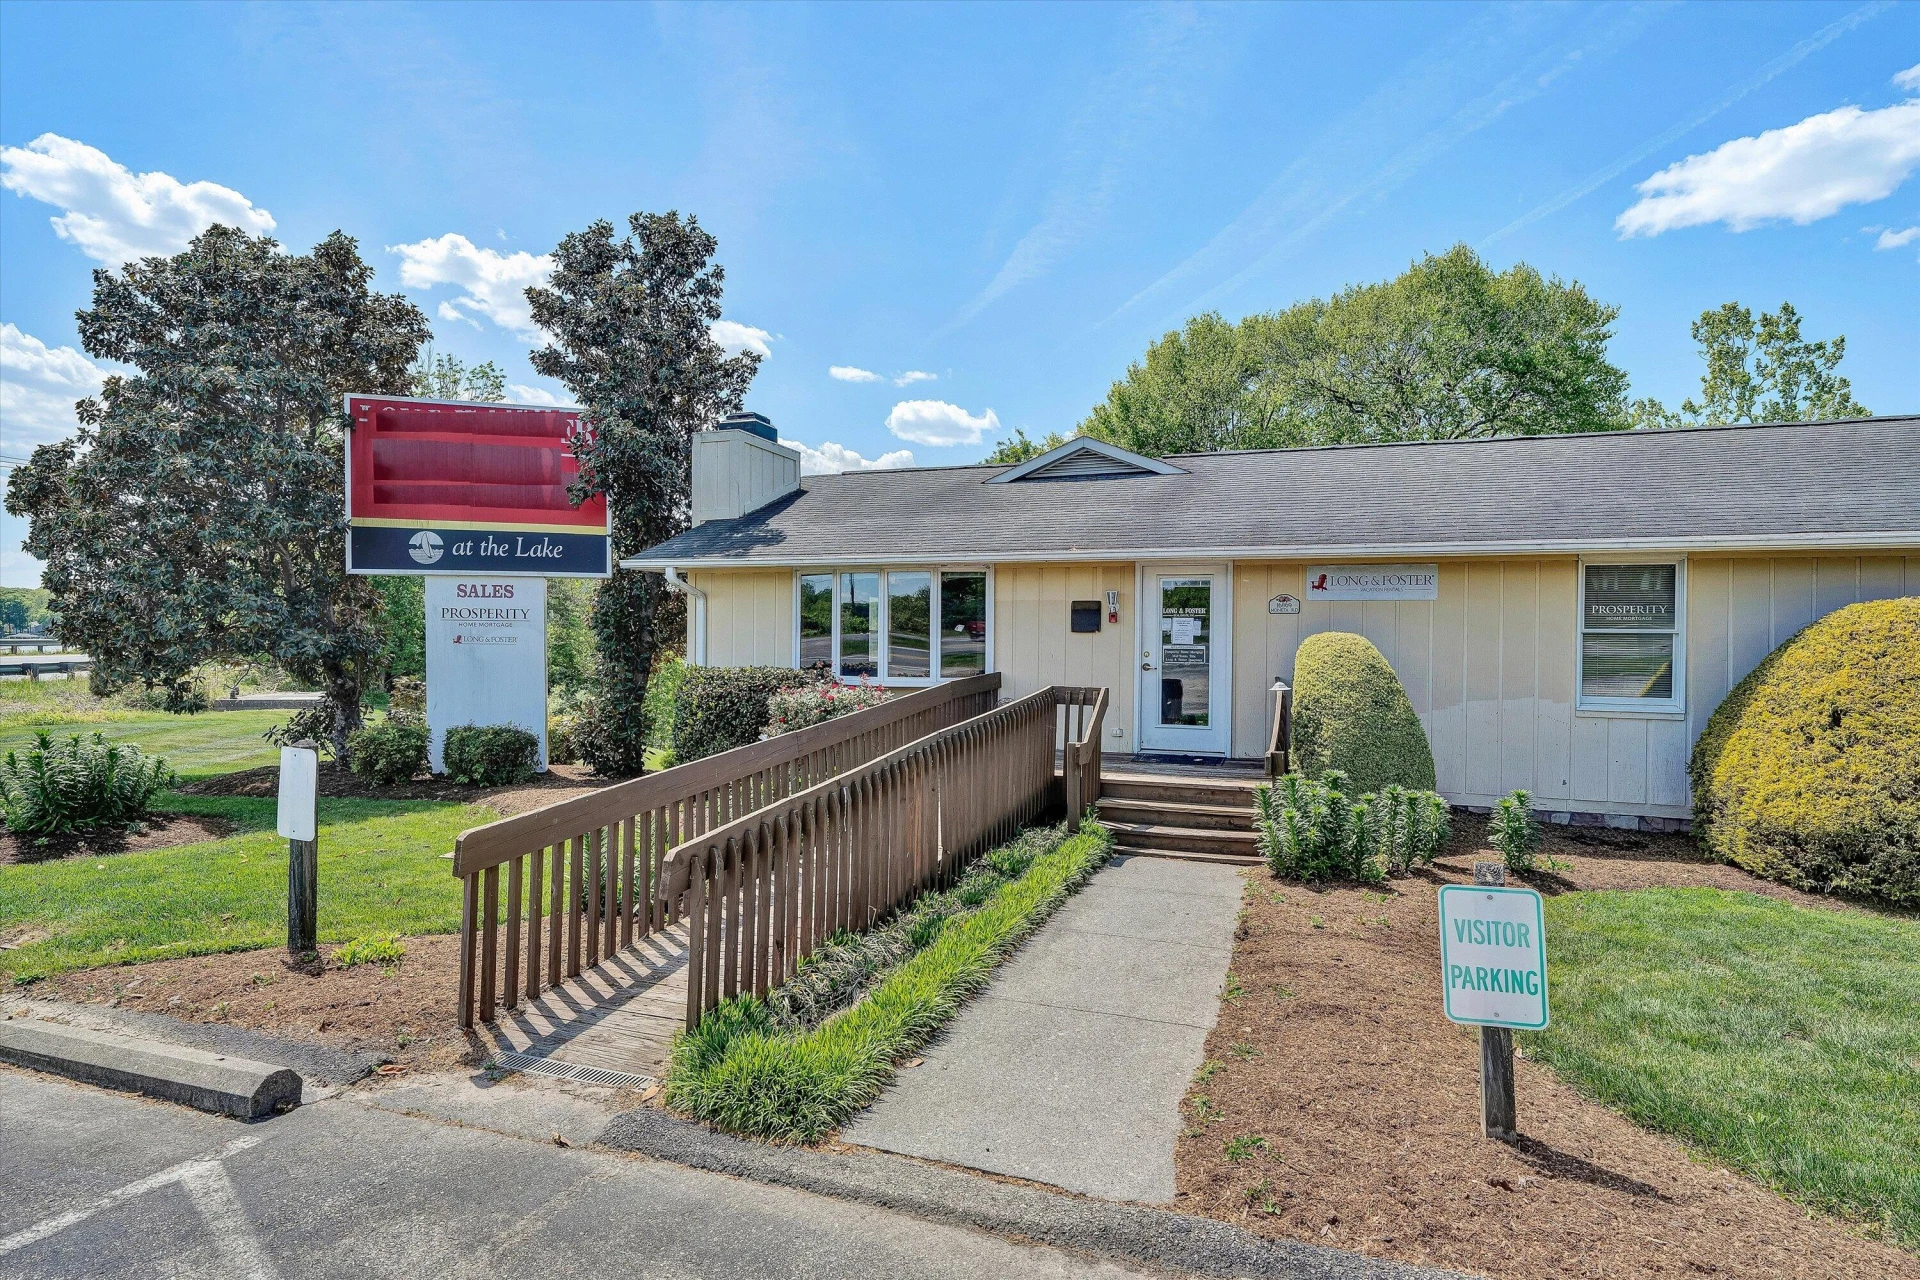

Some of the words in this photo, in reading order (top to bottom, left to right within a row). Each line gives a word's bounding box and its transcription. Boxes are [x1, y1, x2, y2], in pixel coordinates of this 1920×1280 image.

[452, 540, 473, 556] at
[480, 536, 509, 557] the
[515, 537, 563, 558] Lake
[1330, 575, 1368, 586] LONG
[1371, 575, 1380, 586] &
[1382, 574, 1433, 586] FOSTER
[457, 584, 514, 598] SALES
[442, 608, 530, 619] PROSPERITY
[1591, 605, 1668, 614] PROSPERITY
[463, 635, 484, 643] LONG
[1454, 919, 1530, 948] VISITOR
[1451, 965, 1538, 995] PARKING
